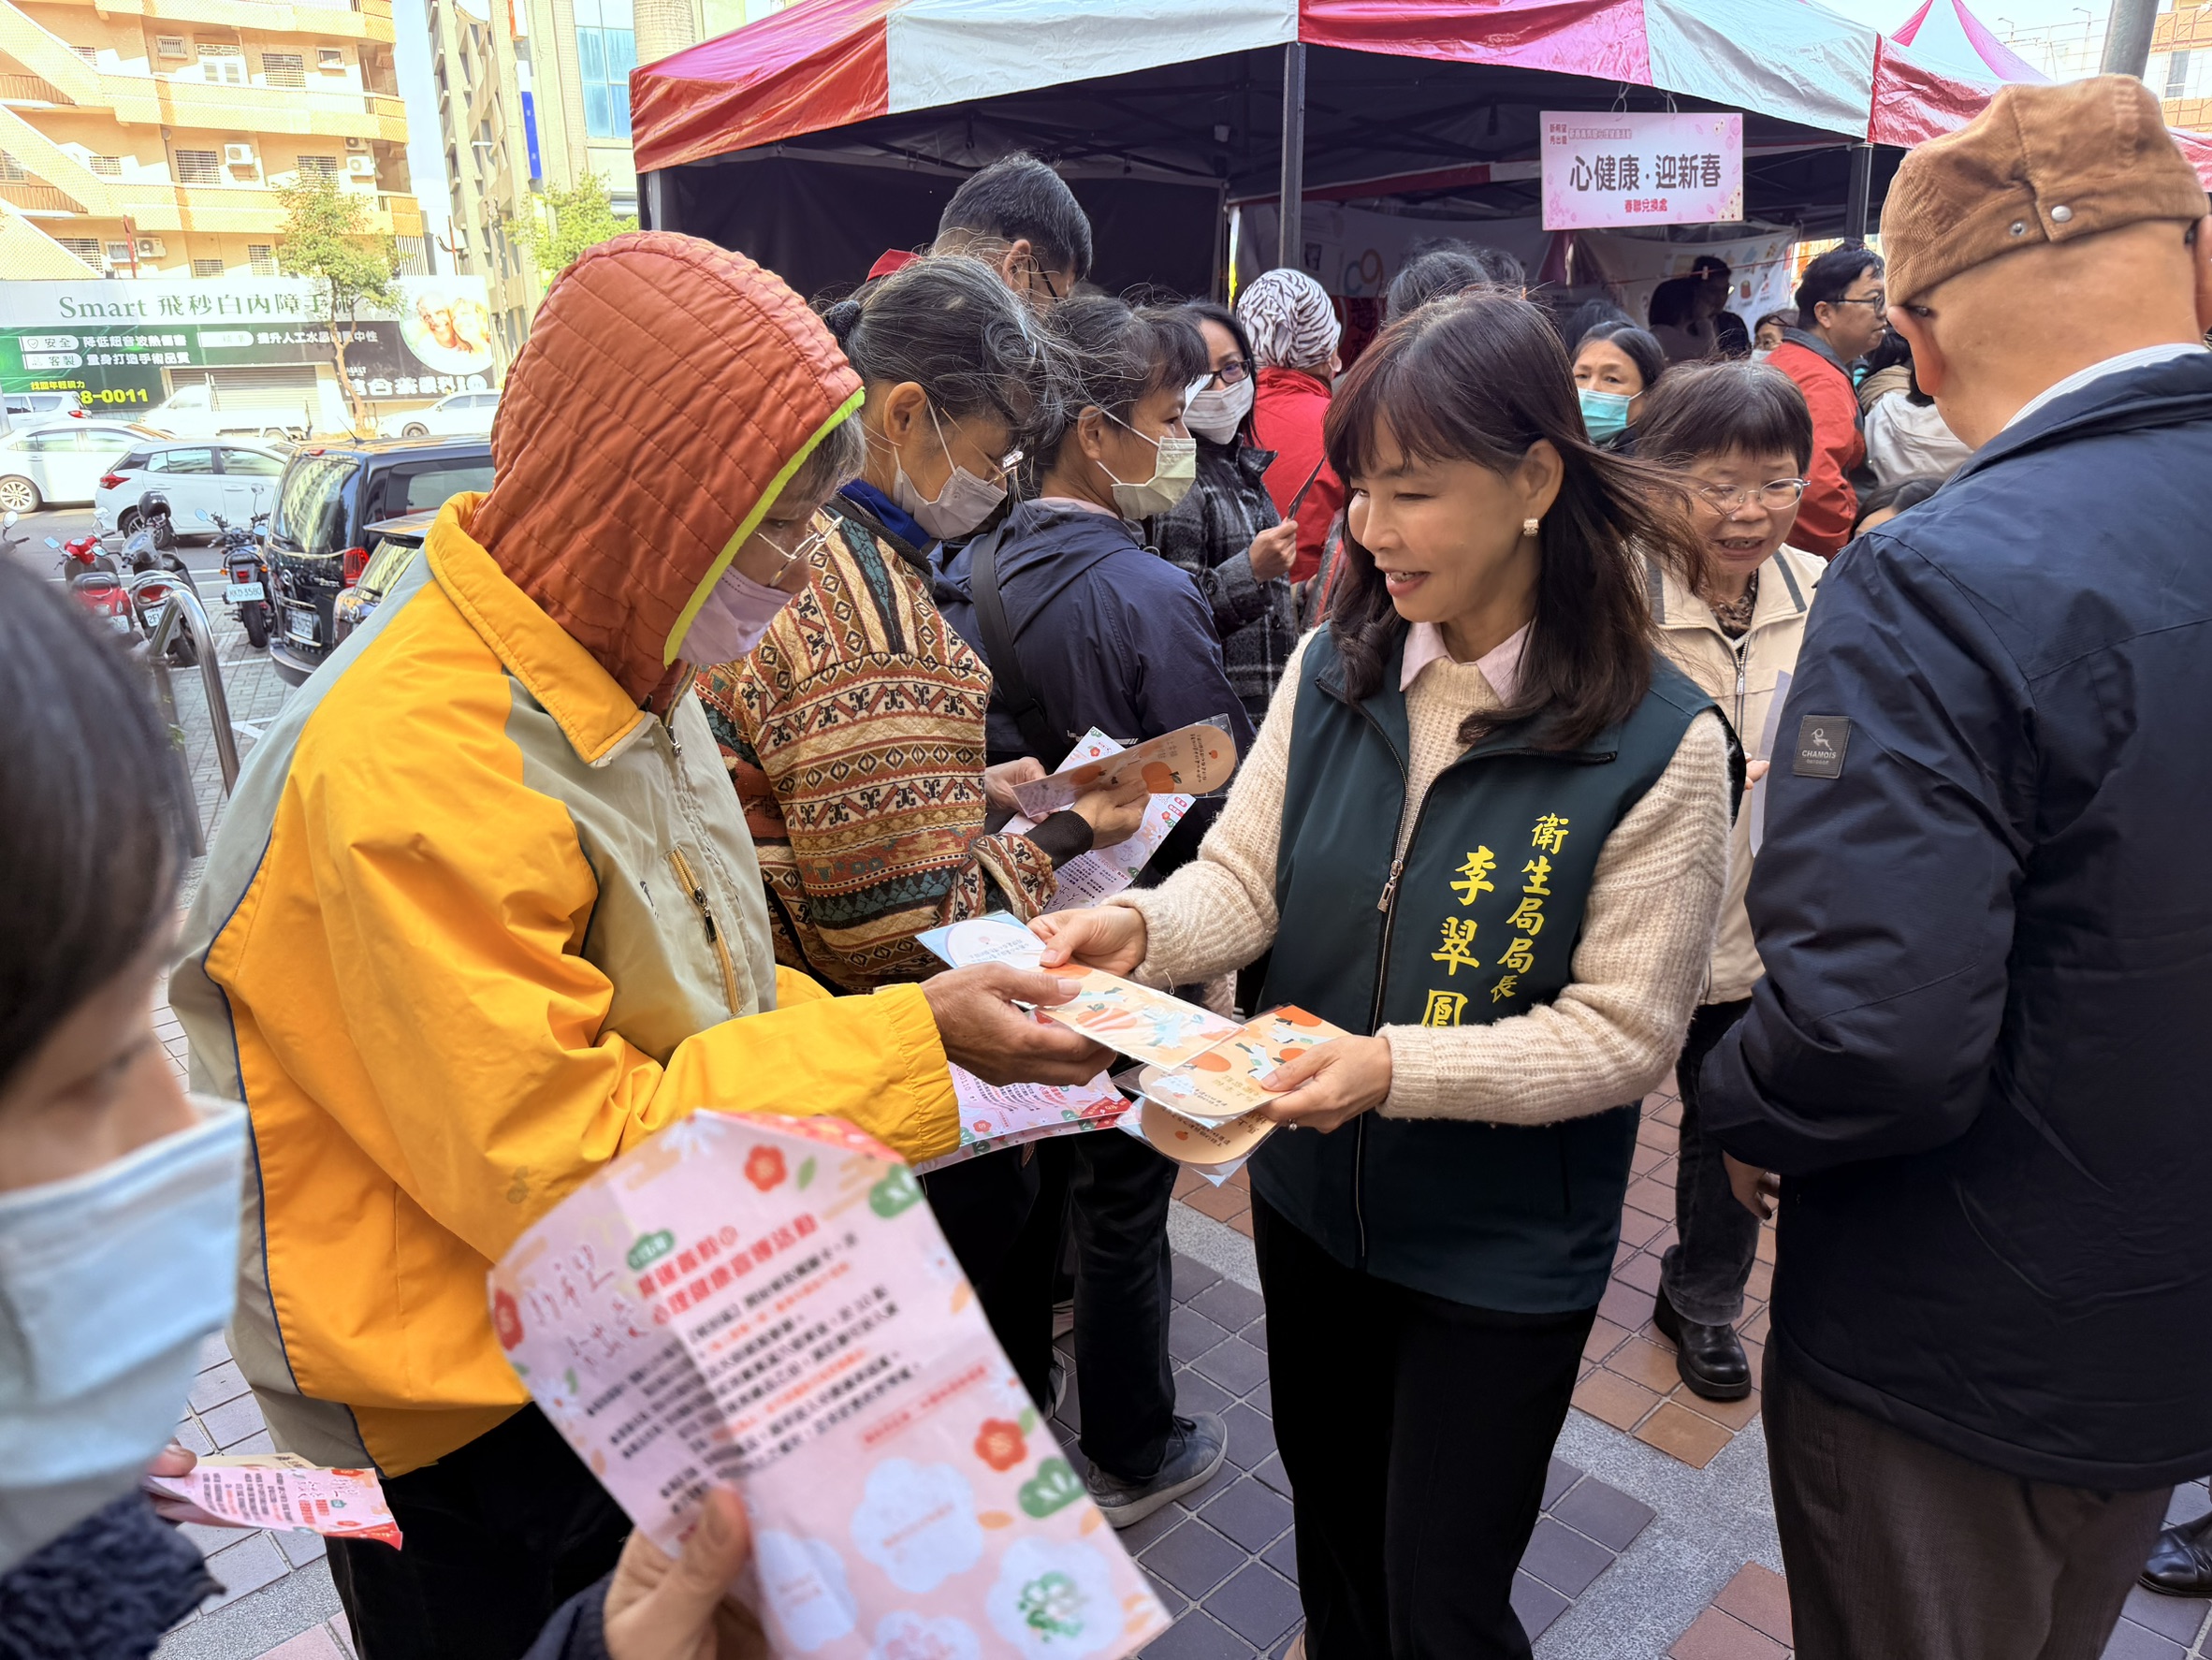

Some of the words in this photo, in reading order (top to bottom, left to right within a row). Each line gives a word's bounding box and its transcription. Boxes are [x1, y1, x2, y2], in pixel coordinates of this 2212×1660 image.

[59, 296, 148, 318] Smart
[44, 338, 71, 349] 安全
[1801, 750, 1837, 759] CHAMOIS
[1490, 812, 1570, 1003] 衛生局局長
